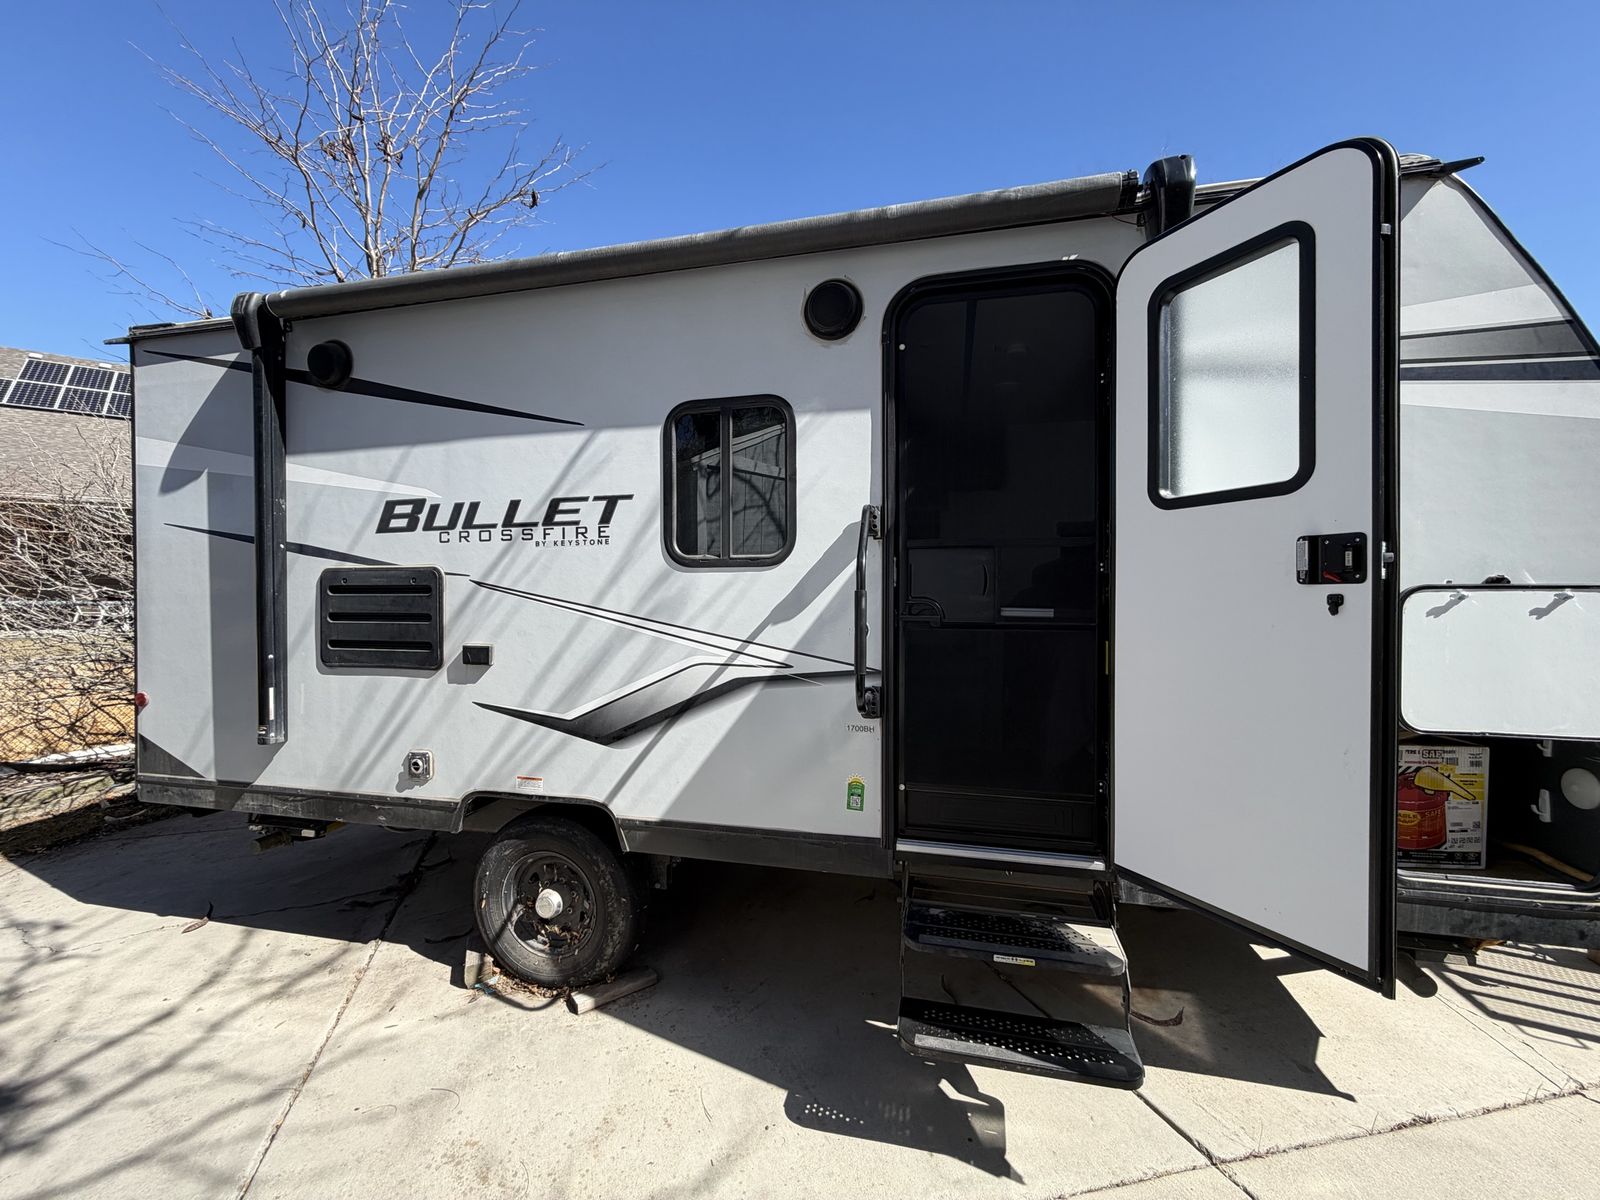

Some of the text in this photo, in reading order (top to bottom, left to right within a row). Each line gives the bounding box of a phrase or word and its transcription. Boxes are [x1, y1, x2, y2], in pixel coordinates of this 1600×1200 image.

[375, 494, 634, 534] BULLET
[439, 525, 610, 543] CROSSFIRE
[554, 538, 610, 547] KEYSTONE
[847, 724, 875, 733] 1700BH
